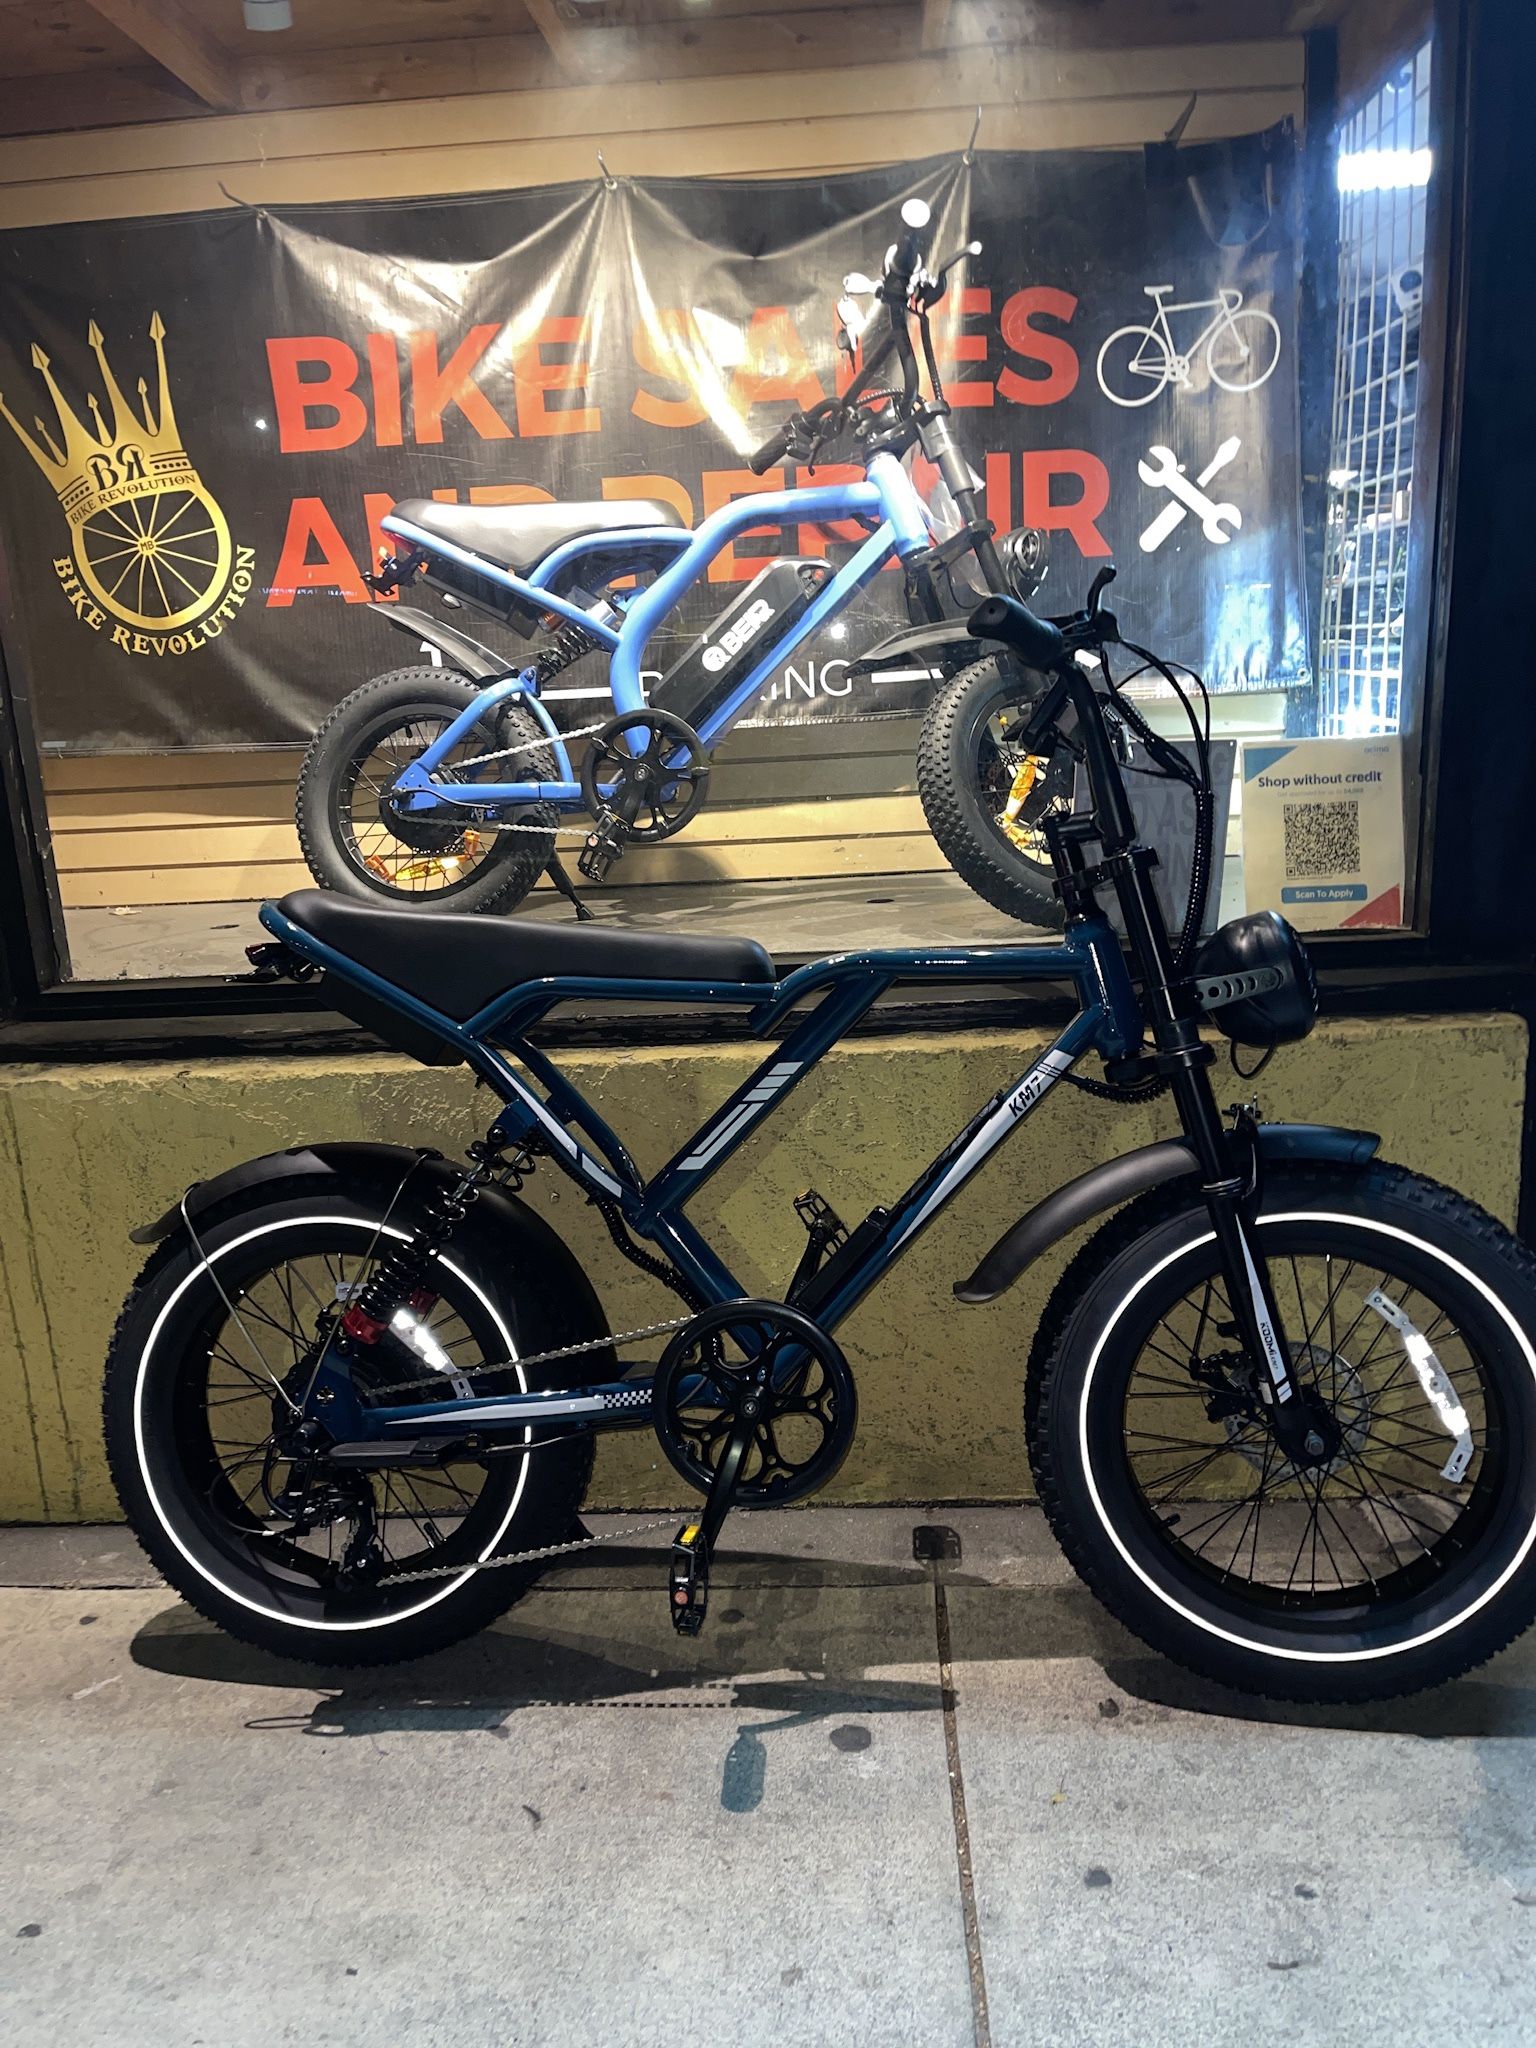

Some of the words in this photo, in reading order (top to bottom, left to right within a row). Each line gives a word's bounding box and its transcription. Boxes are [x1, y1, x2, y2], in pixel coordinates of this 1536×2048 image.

[265, 316, 601, 454] BIKE
[69, 502, 97, 525] BIKE
[98, 474, 196, 505] REVOLUTION
[52, 555, 107, 631] BIKE
[110, 545, 256, 657] REVOLUTION
[1258, 776, 1291, 789] Shop
[1294, 773, 1342, 786] without
[1345, 770, 1382, 783] credit
[1295, 890, 1315, 899] Scan
[1317, 889, 1327, 898] To
[1328, 888, 1354, 899] Apply
[1008, 1075, 1043, 1118] KM7
